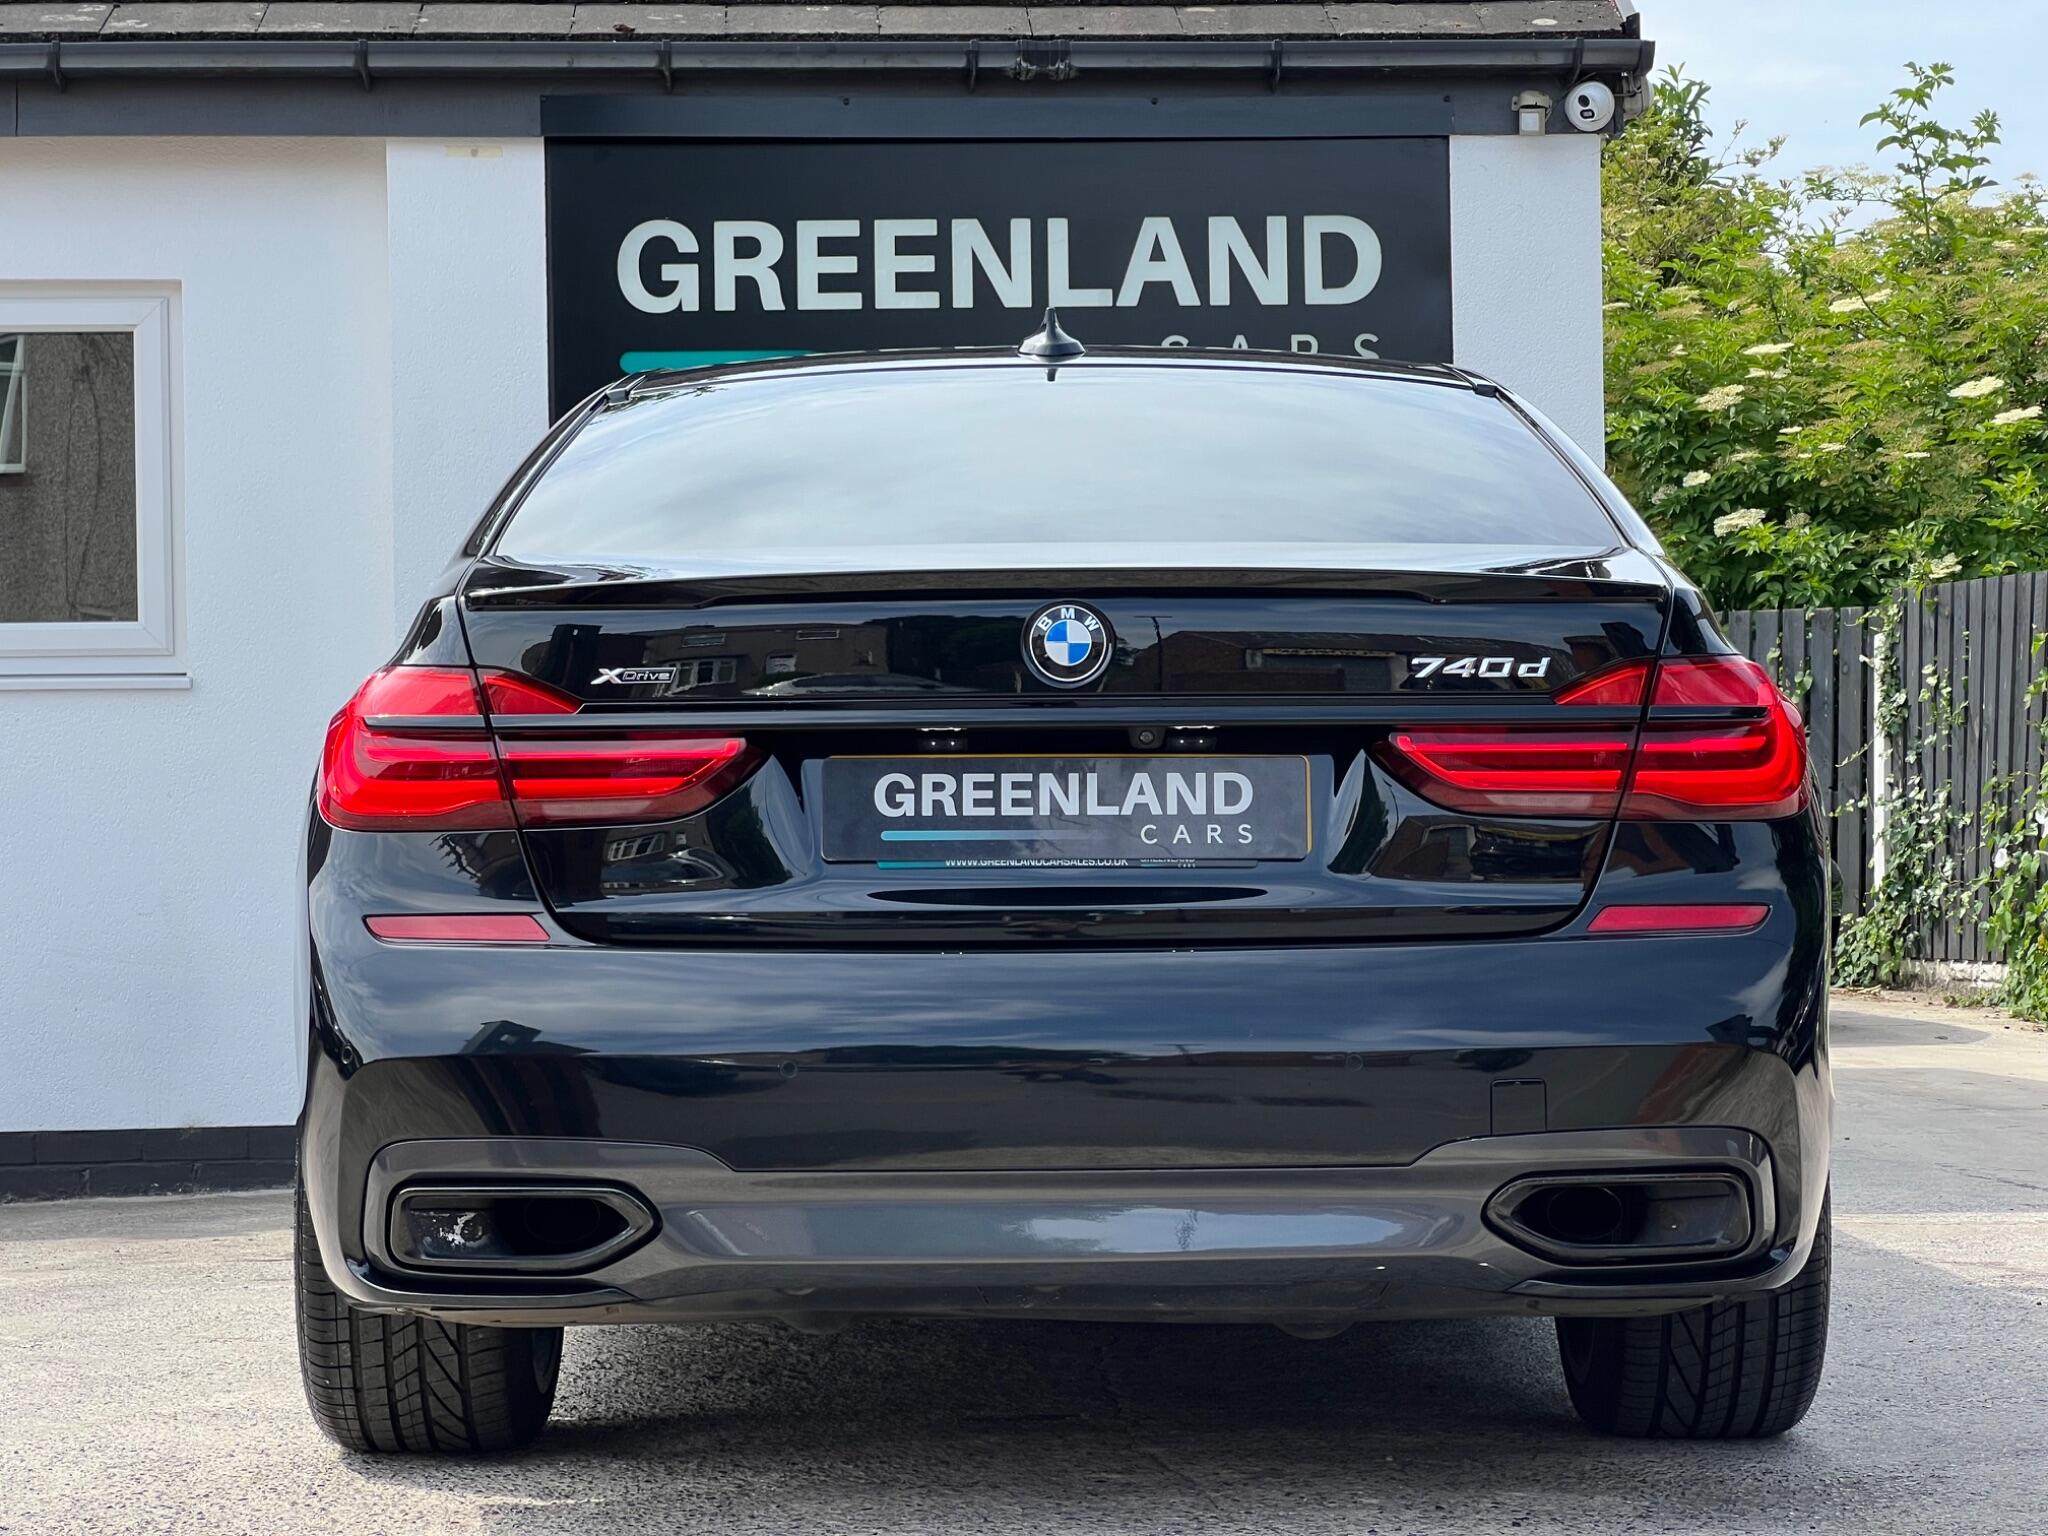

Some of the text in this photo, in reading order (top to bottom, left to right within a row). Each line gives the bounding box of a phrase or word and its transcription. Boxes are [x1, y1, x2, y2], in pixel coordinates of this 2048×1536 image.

[616, 214, 1383, 314] GREENLAND
[1037, 607, 1100, 632] BMW
[1411, 656, 1551, 678] 740d
[873, 772, 1255, 818] GREENLAND
[1140, 823, 1254, 845] CARS
